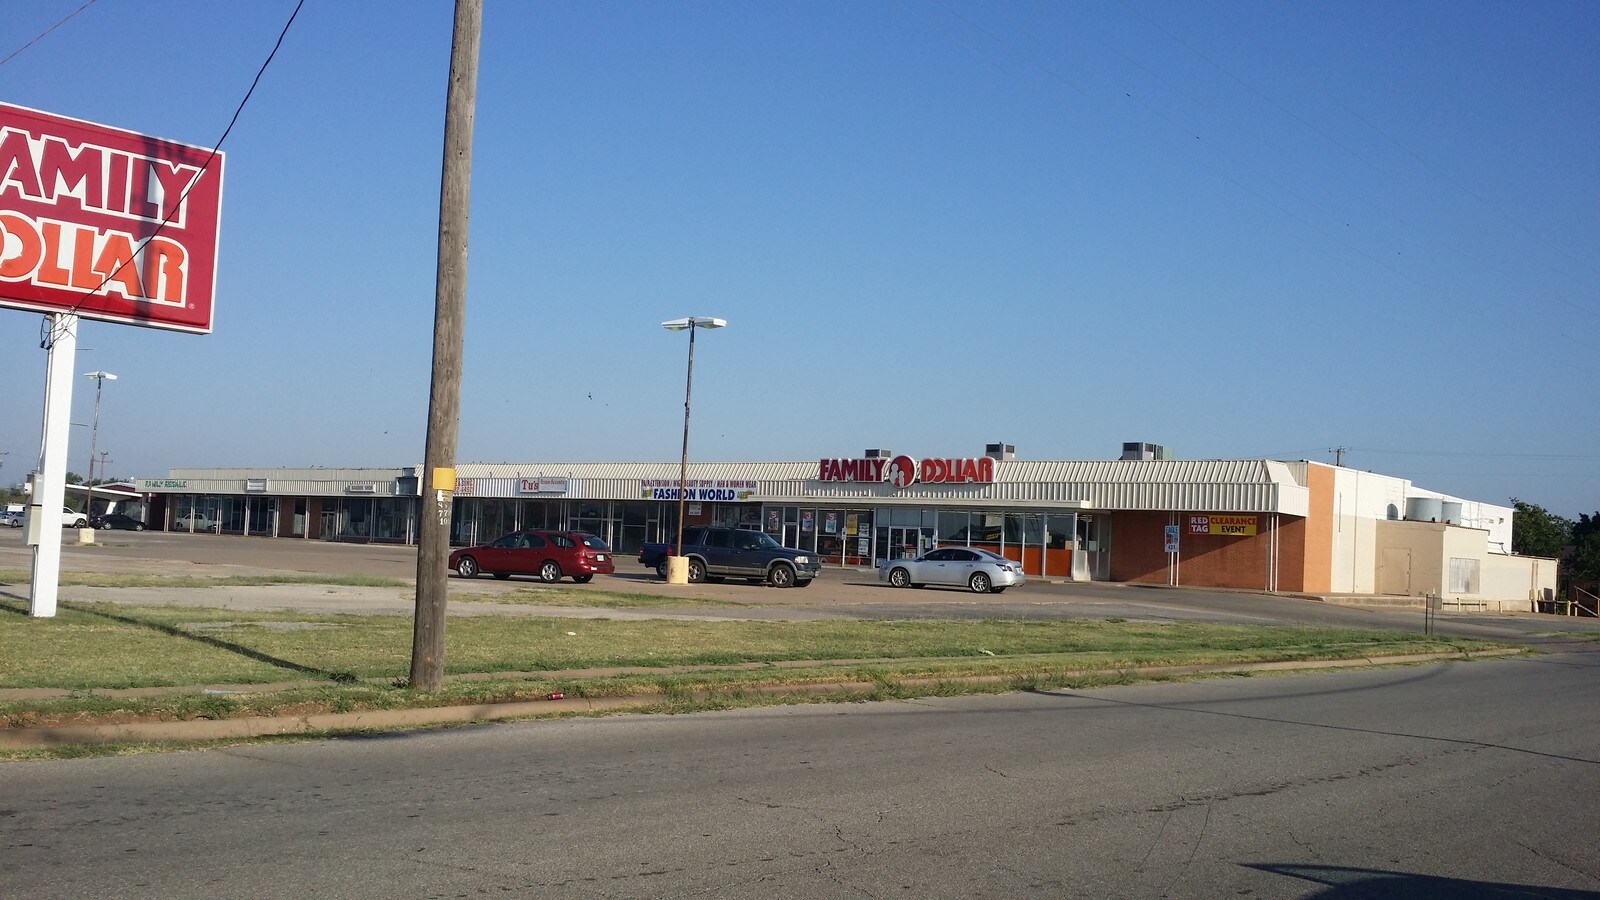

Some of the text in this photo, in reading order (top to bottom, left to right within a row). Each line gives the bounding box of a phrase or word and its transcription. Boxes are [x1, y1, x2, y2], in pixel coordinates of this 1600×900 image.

[0, 209, 189, 308] OLLAR
[819, 456, 996, 483] FAMILY DOLLAR
[654, 488, 696, 500] FASHION
[699, 489, 735, 500] WORLD
[1191, 517, 1208, 525] RED
[1210, 518, 1256, 526] CLEARANCE
[1222, 525, 1246, 534] EVENT
